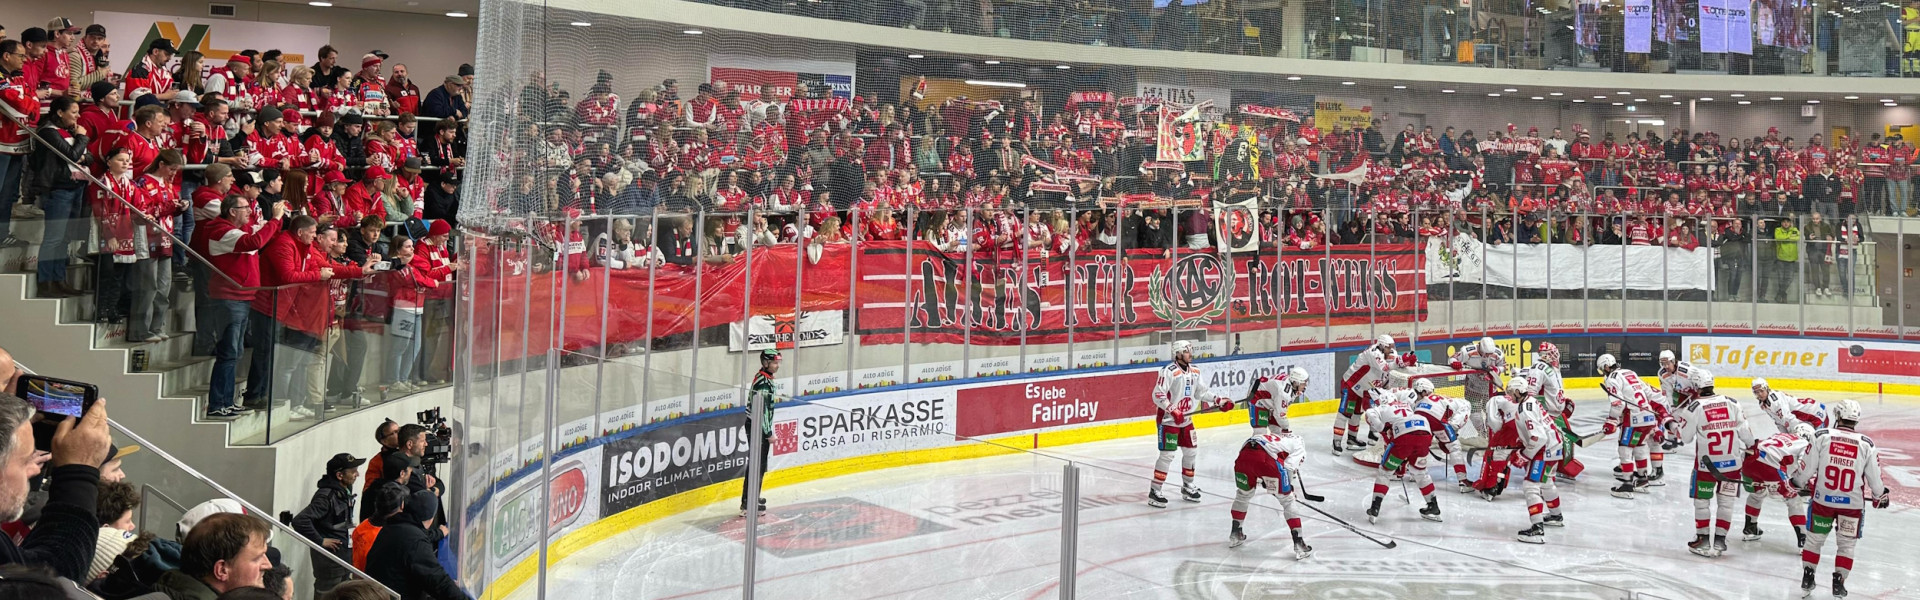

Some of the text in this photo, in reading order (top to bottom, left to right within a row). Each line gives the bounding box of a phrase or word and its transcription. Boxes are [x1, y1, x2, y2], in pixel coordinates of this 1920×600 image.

[1064, 254, 1136, 327] FÜR
[1714, 344, 1829, 370] Taferner
[1025, 384, 1066, 401] Es lebe
[802, 398, 944, 438] SPARKASSE
[1032, 398, 1099, 424] Fairplay
[802, 421, 944, 451] CASSA DI RISPARMIO
[1707, 430, 1734, 456] 27
[609, 424, 749, 488] ISODOMUS
[1830, 456, 1854, 467] FRASER
[608, 480, 651, 503] INDOOR
[655, 466, 702, 488] CLIMATE
[1824, 465, 1856, 492] 90
